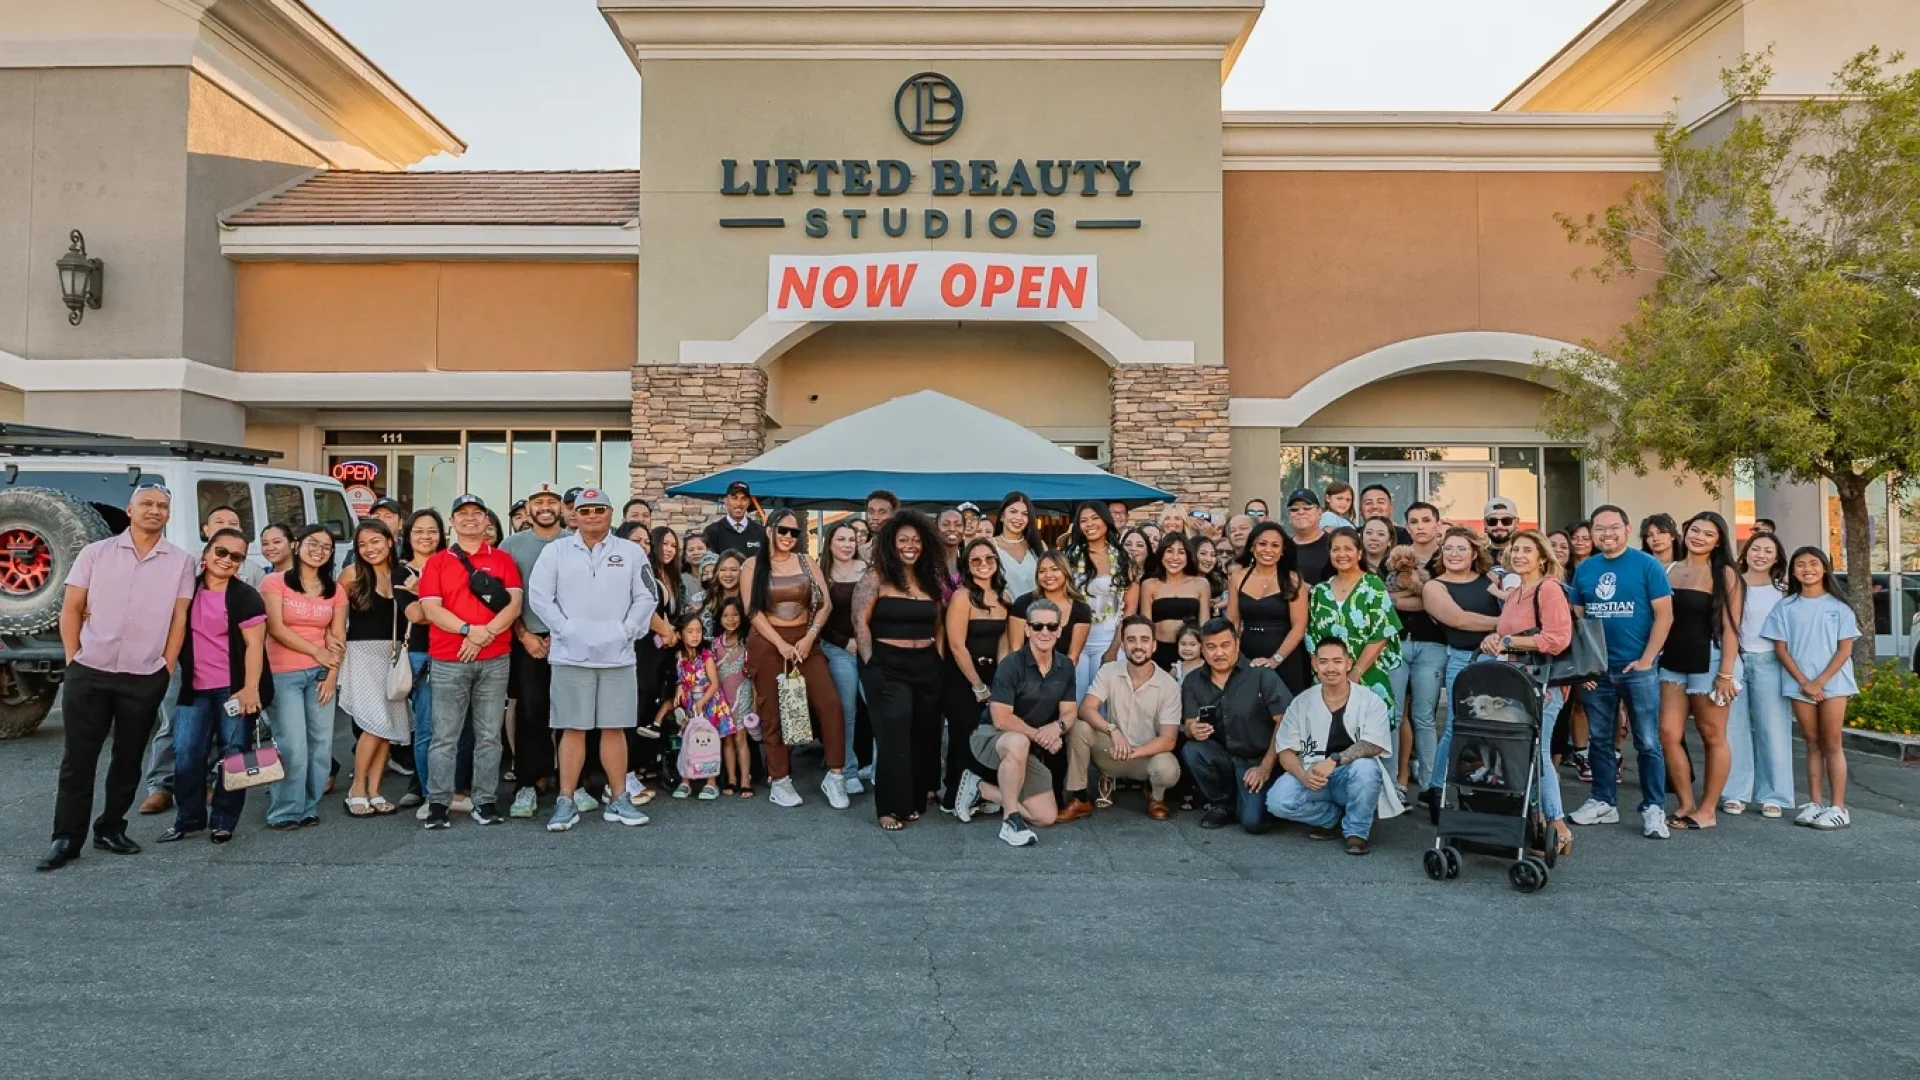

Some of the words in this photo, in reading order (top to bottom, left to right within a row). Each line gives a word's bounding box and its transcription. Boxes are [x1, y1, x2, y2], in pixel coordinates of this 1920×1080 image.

[720, 159, 912, 196] LIFTED
[932, 158, 1141, 196] BEAUTY
[805, 207, 1057, 239] STUDIOS
[777, 263, 918, 309] NOW
[940, 262, 1089, 309] OPEN
[381, 432, 402, 443] 111
[332, 463, 375, 481] OPEN
